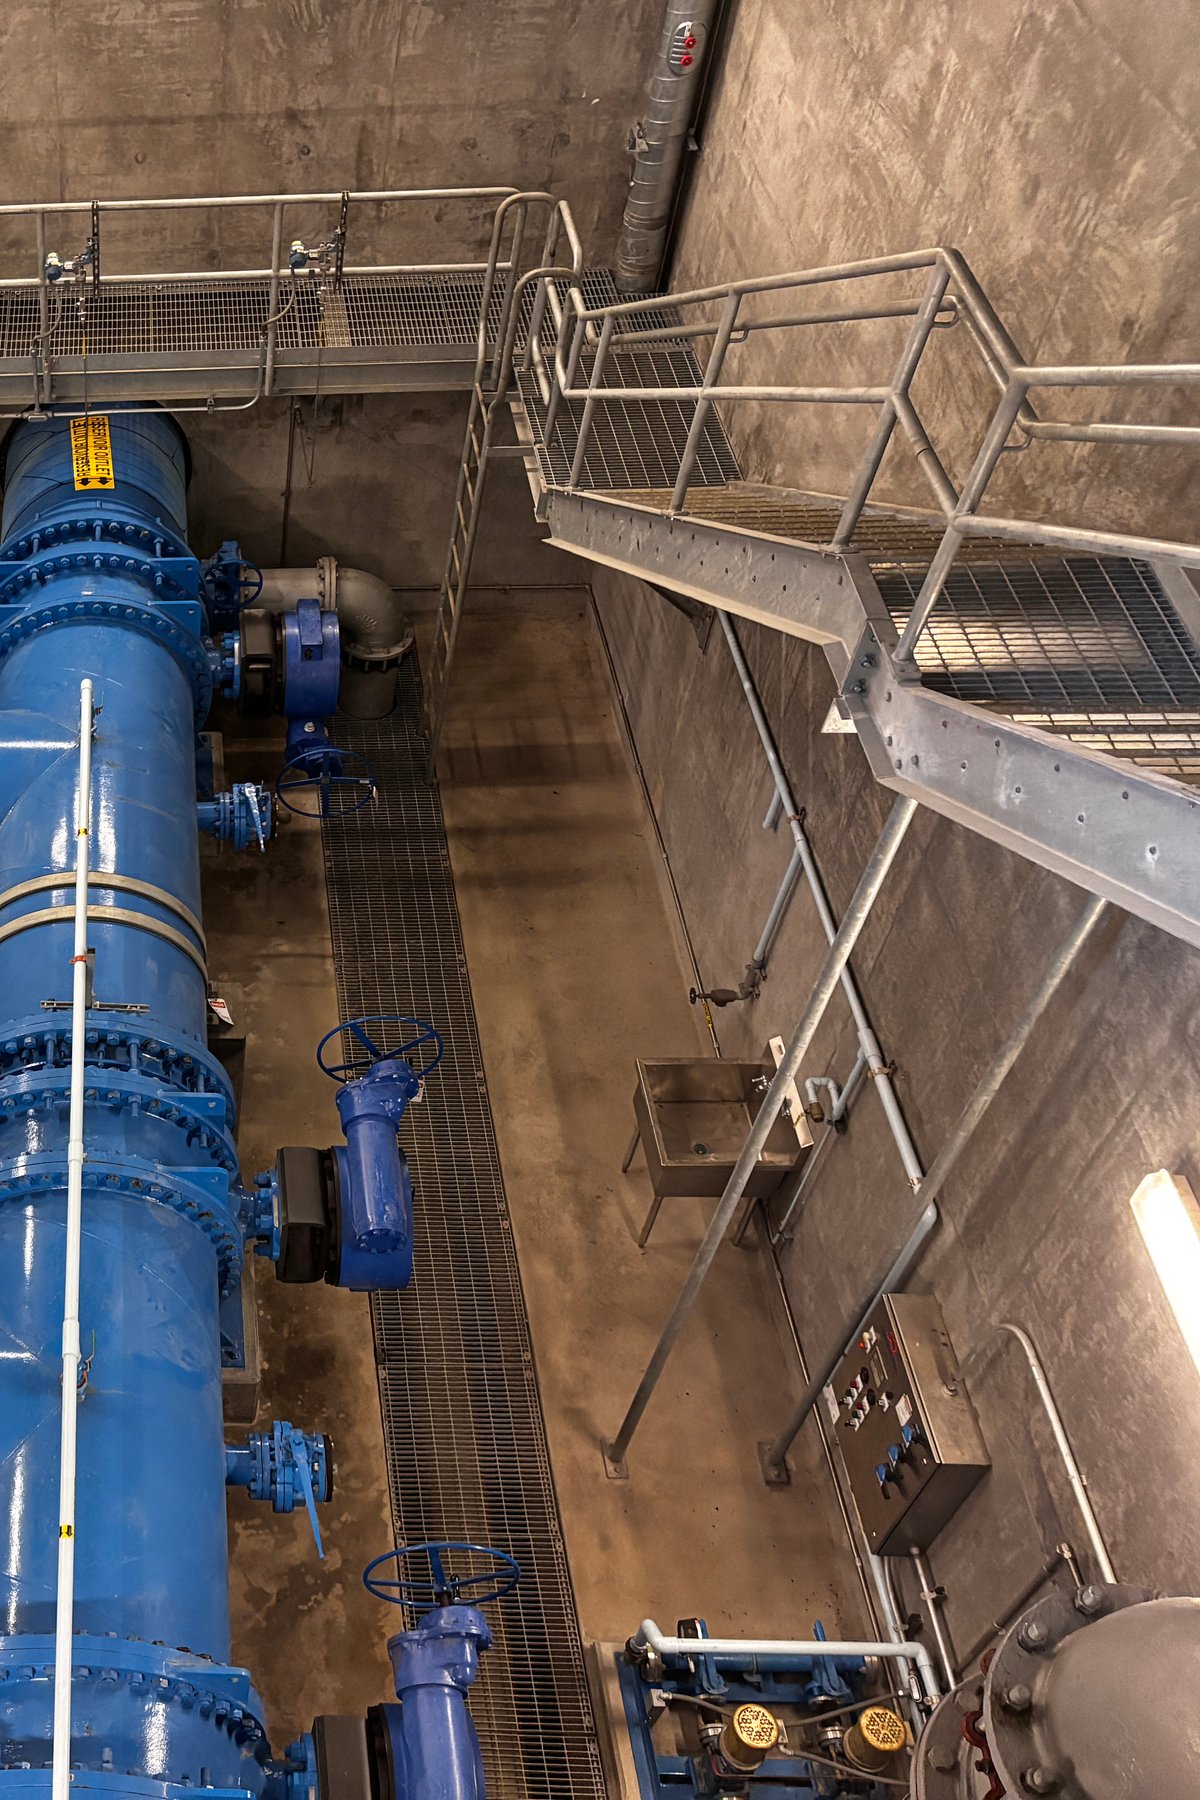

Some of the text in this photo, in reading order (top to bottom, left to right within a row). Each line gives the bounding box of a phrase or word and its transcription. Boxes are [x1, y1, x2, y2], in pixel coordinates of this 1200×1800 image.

[72, 418, 91, 477] RESERVOIR OUTLET
[91, 417, 110, 476] RESERVOIR OUTLET
